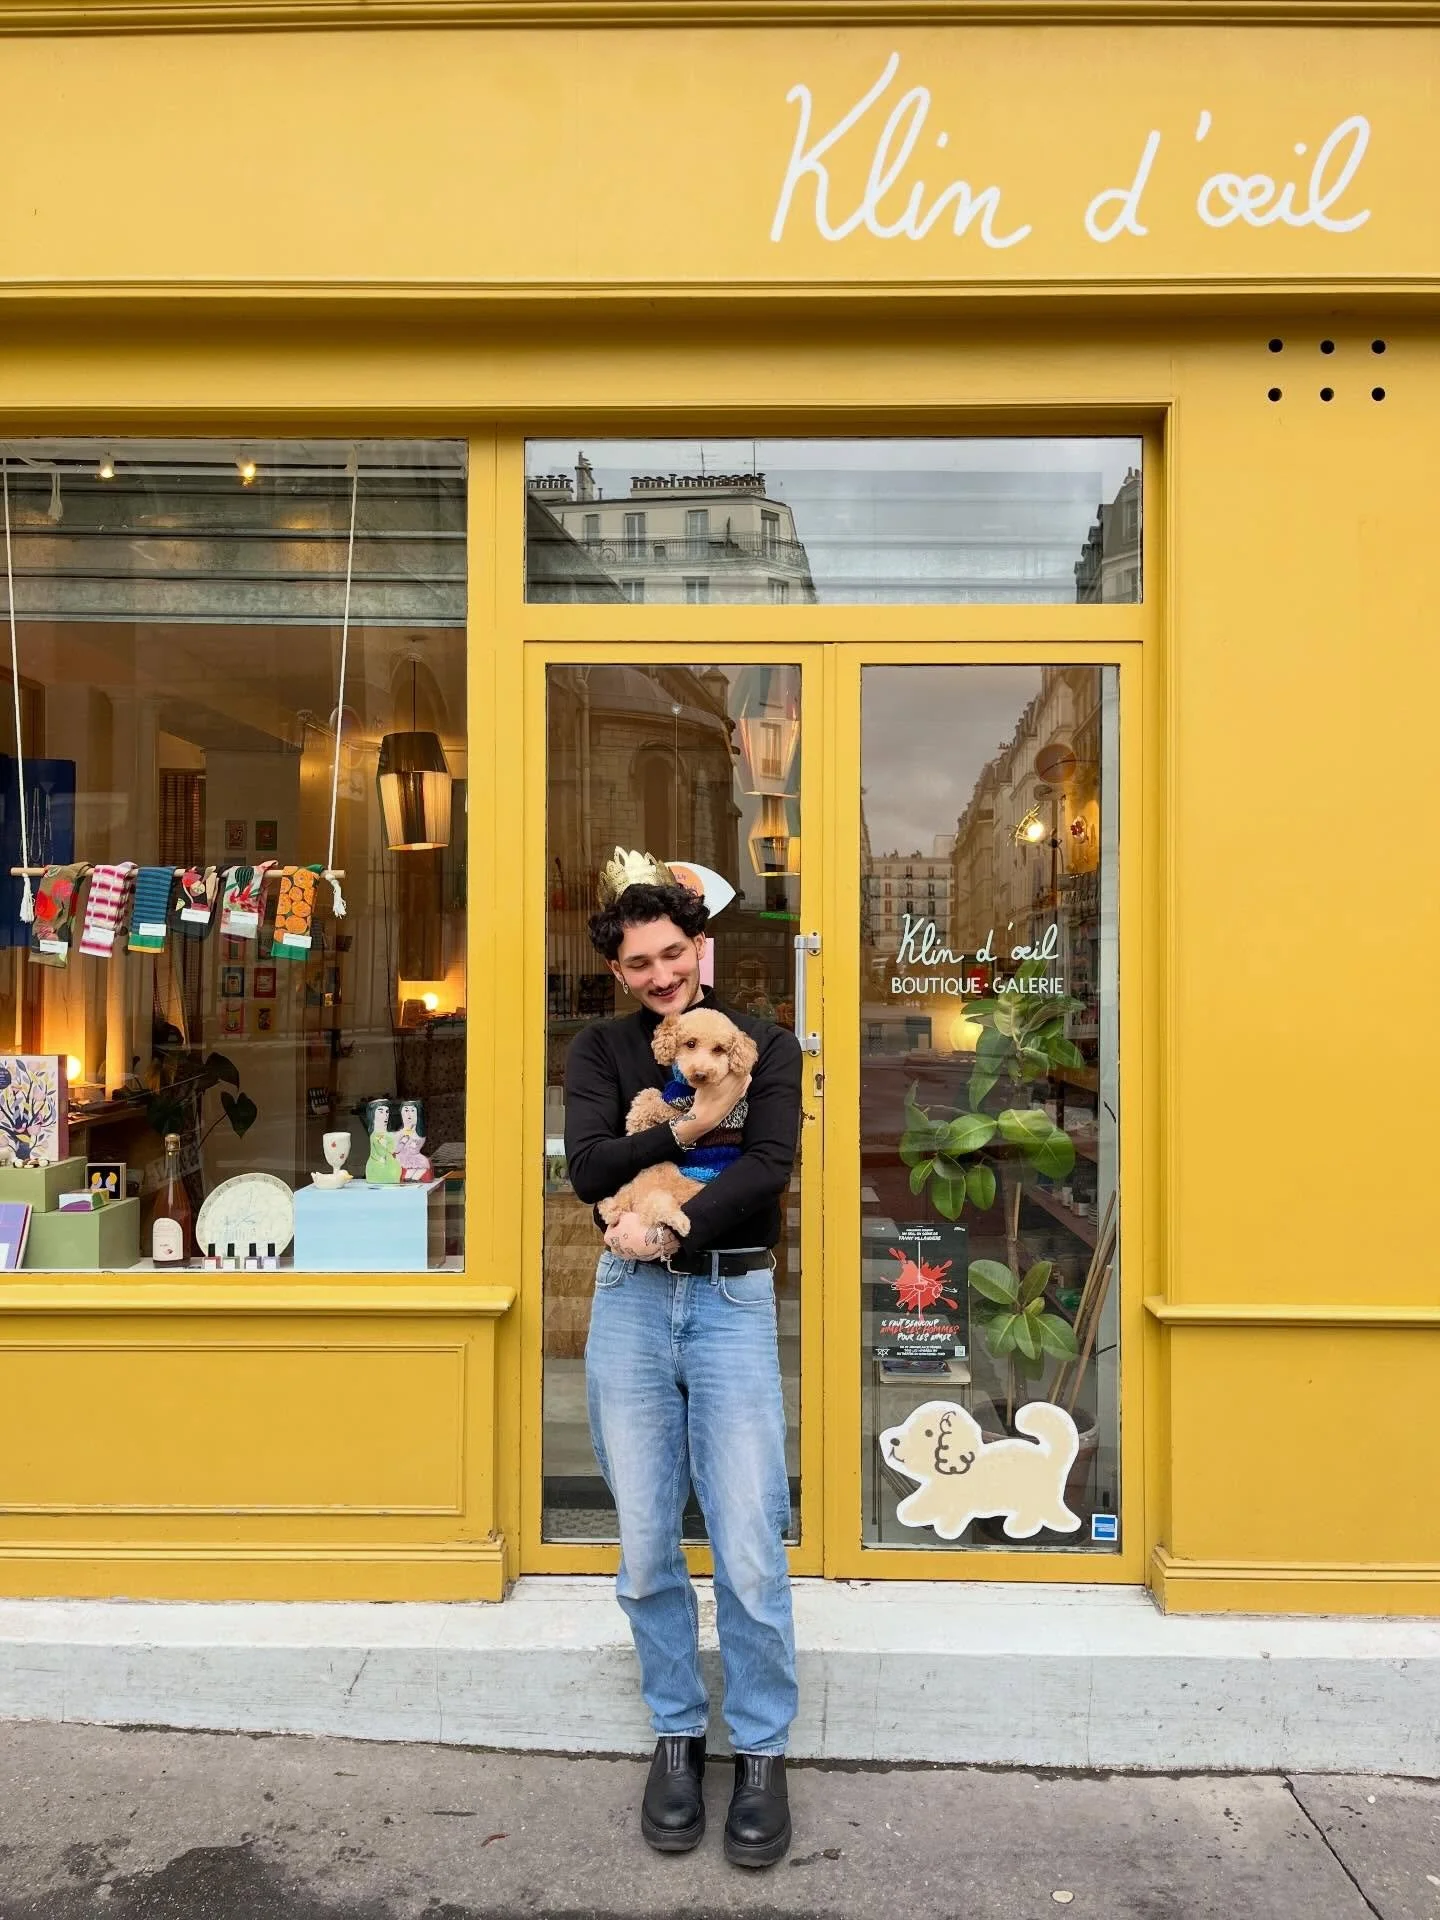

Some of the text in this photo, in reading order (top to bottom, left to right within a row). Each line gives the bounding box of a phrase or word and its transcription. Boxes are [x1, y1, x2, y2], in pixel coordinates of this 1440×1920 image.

[770, 51, 1032, 249] Klin
[895, 913, 965, 966] Klin
[992, 976, 1064, 994] GALERIE
[905, 1318, 940, 1328] BEAUCOUP
[897, 1332, 915, 1342] POUR
[916, 1332, 930, 1342] LES
